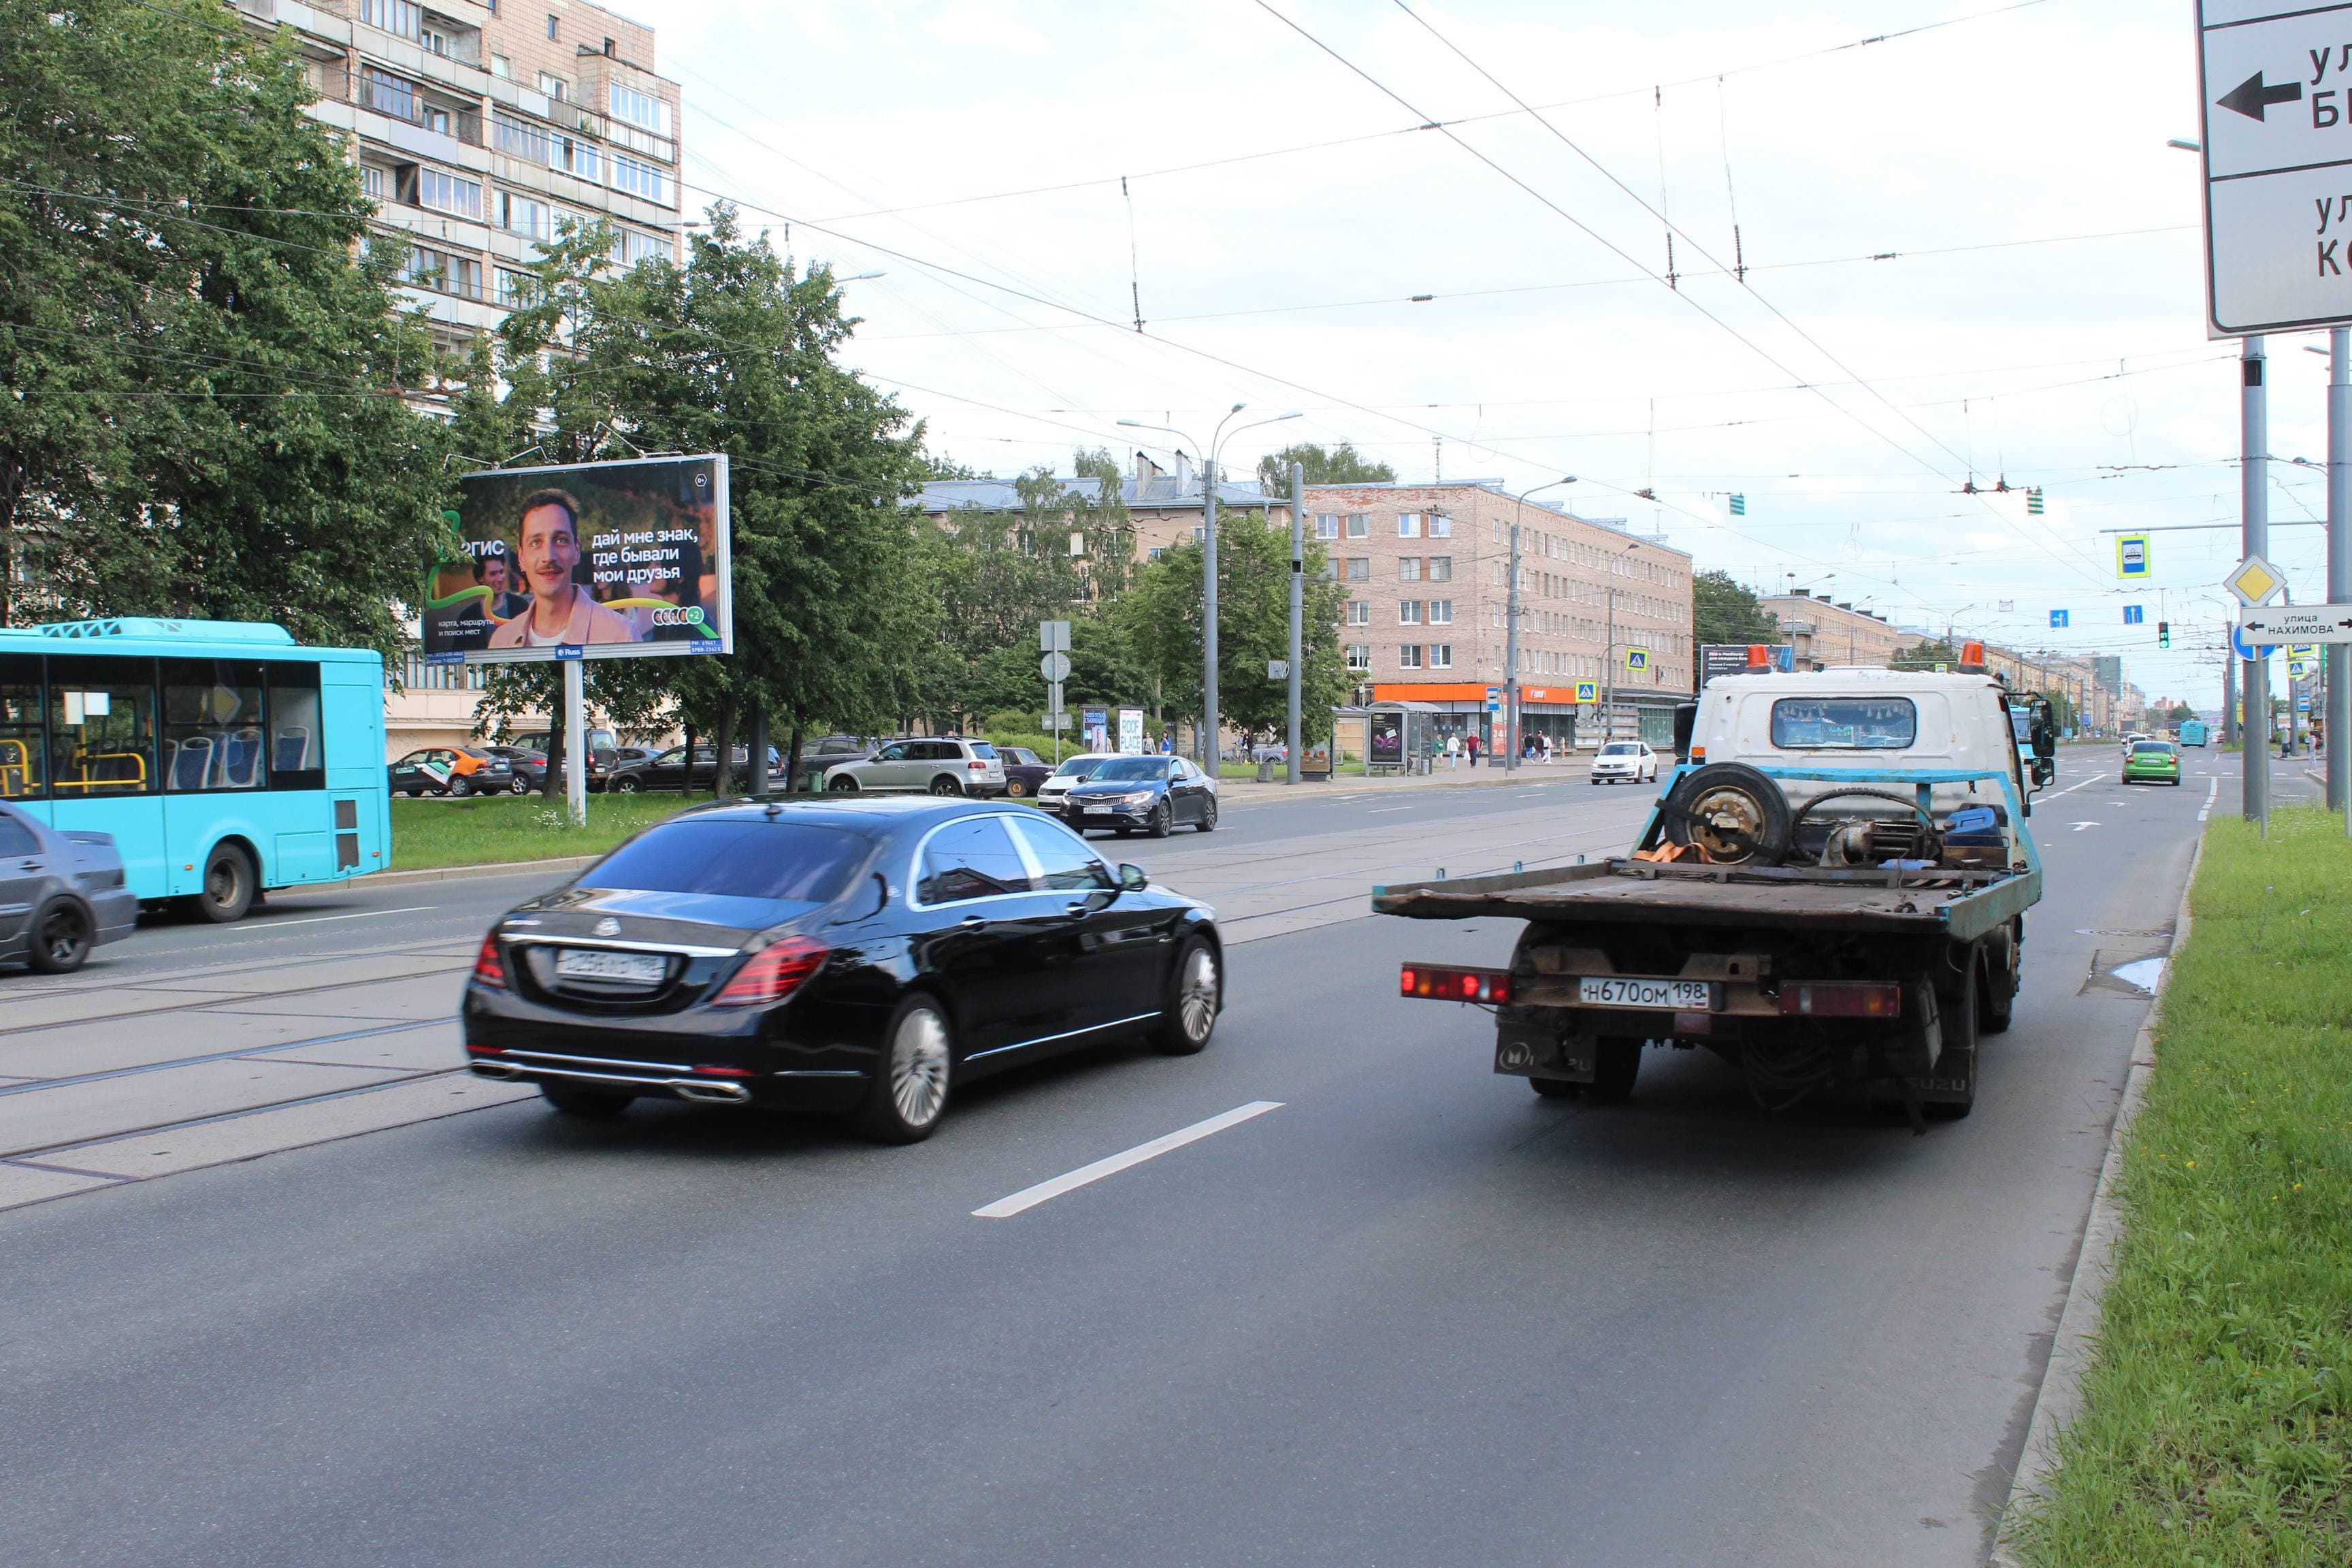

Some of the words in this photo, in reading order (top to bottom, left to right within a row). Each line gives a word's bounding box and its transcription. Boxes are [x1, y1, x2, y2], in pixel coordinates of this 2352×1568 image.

[2313, 88, 2352, 129] Б
[592, 528, 620, 549] дай
[624, 531, 654, 544] мне
[657, 528, 698, 543] знак,
[593, 552, 618, 566] где
[621, 546, 679, 563] бывали
[593, 570, 623, 583] мои
[627, 566, 681, 584] друзья
[689, 611, 700, 619] +2
[2284, 615, 2317, 624] улица
[438, 620, 459, 628] карта,
[2268, 625, 2334, 635] НАХИМОВА
[1122, 719, 1139, 734] ROOF
[1120, 736, 1141, 749] PLACE
[1673, 983, 1703, 998] 198
